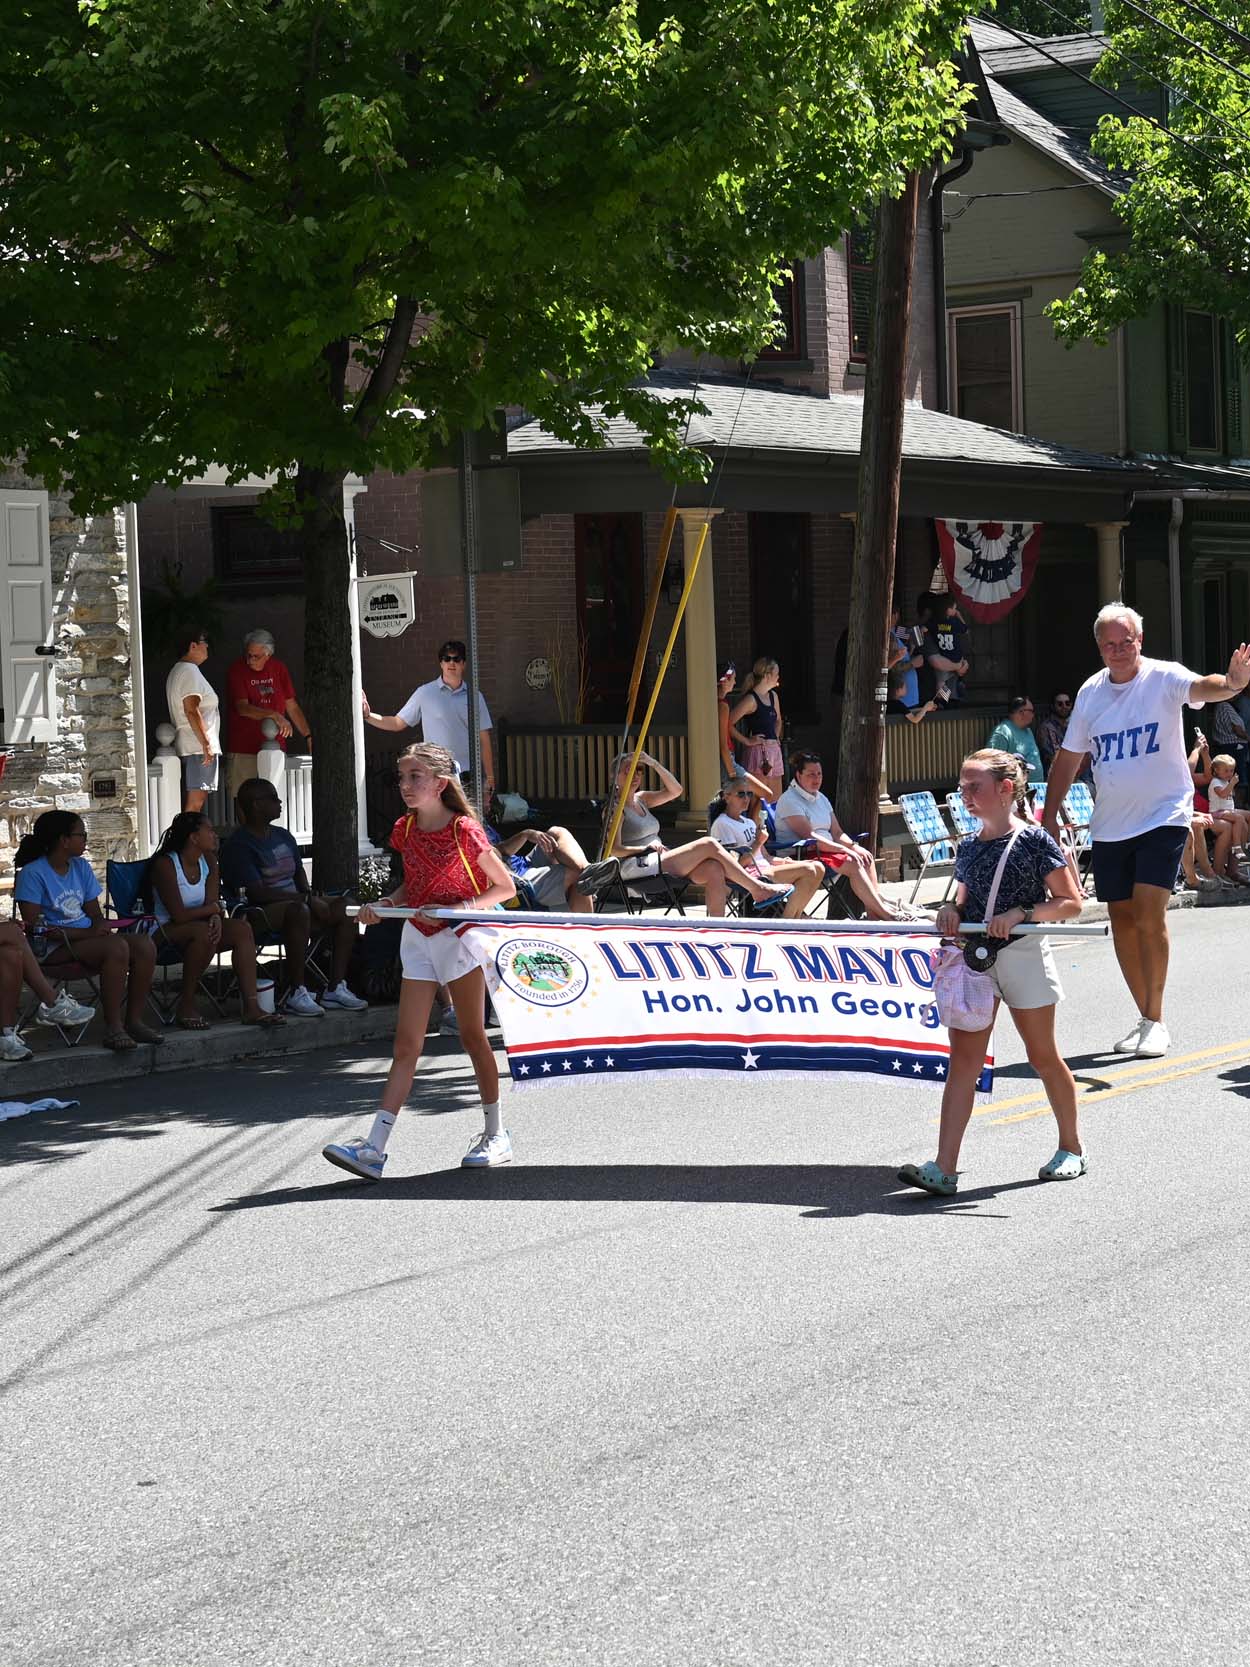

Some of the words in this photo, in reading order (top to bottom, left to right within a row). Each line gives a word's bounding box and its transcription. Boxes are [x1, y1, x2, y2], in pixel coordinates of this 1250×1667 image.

[372, 620, 401, 629] MUSEUM
[500, 943, 521, 967] LITITZ
[521, 941, 577, 963] BOROUGH
[595, 941, 778, 982] LITITZ
[778, 944, 936, 991] MAYO
[514, 982, 558, 1001] Founded
[642, 990, 723, 1013] Hon.
[735, 988, 819, 1013] John
[831, 991, 941, 1029] Georg
